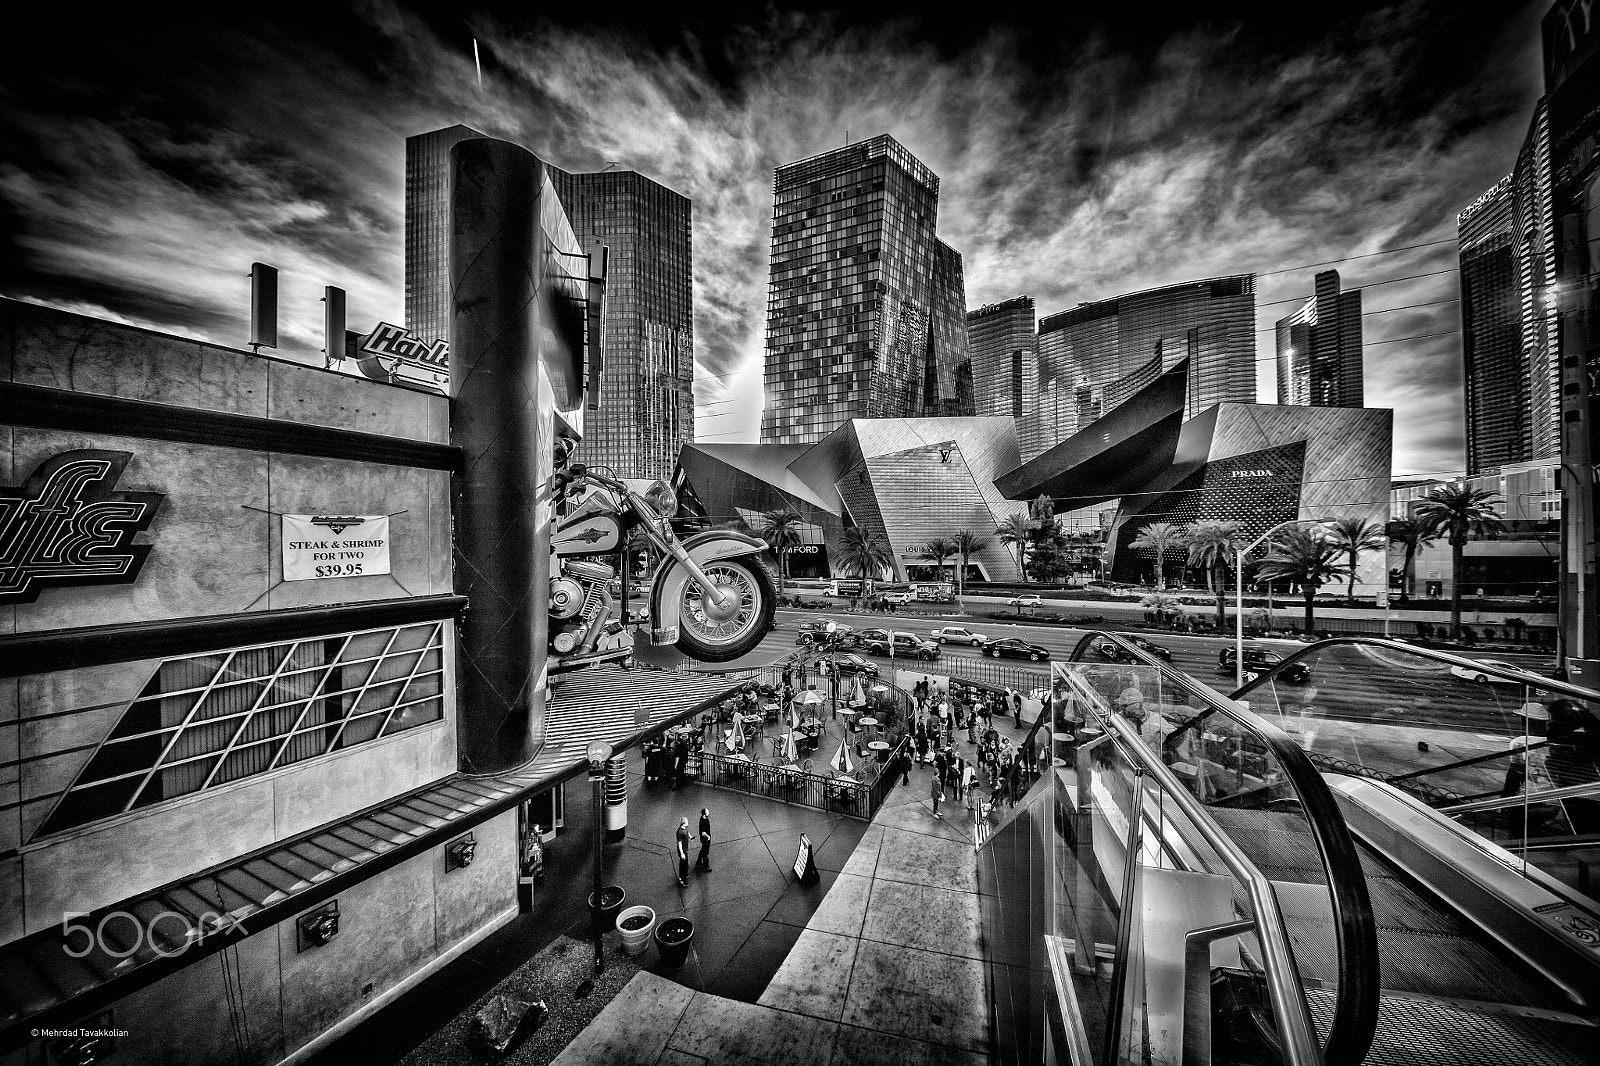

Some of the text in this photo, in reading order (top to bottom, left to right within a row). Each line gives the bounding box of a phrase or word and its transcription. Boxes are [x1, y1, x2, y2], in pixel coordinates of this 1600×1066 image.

[289, 541, 328, 549] STEAK
[342, 540, 384, 548] SHRIMP
[313, 551, 364, 560] FOR TWO
[315, 563, 363, 577] $39.95
